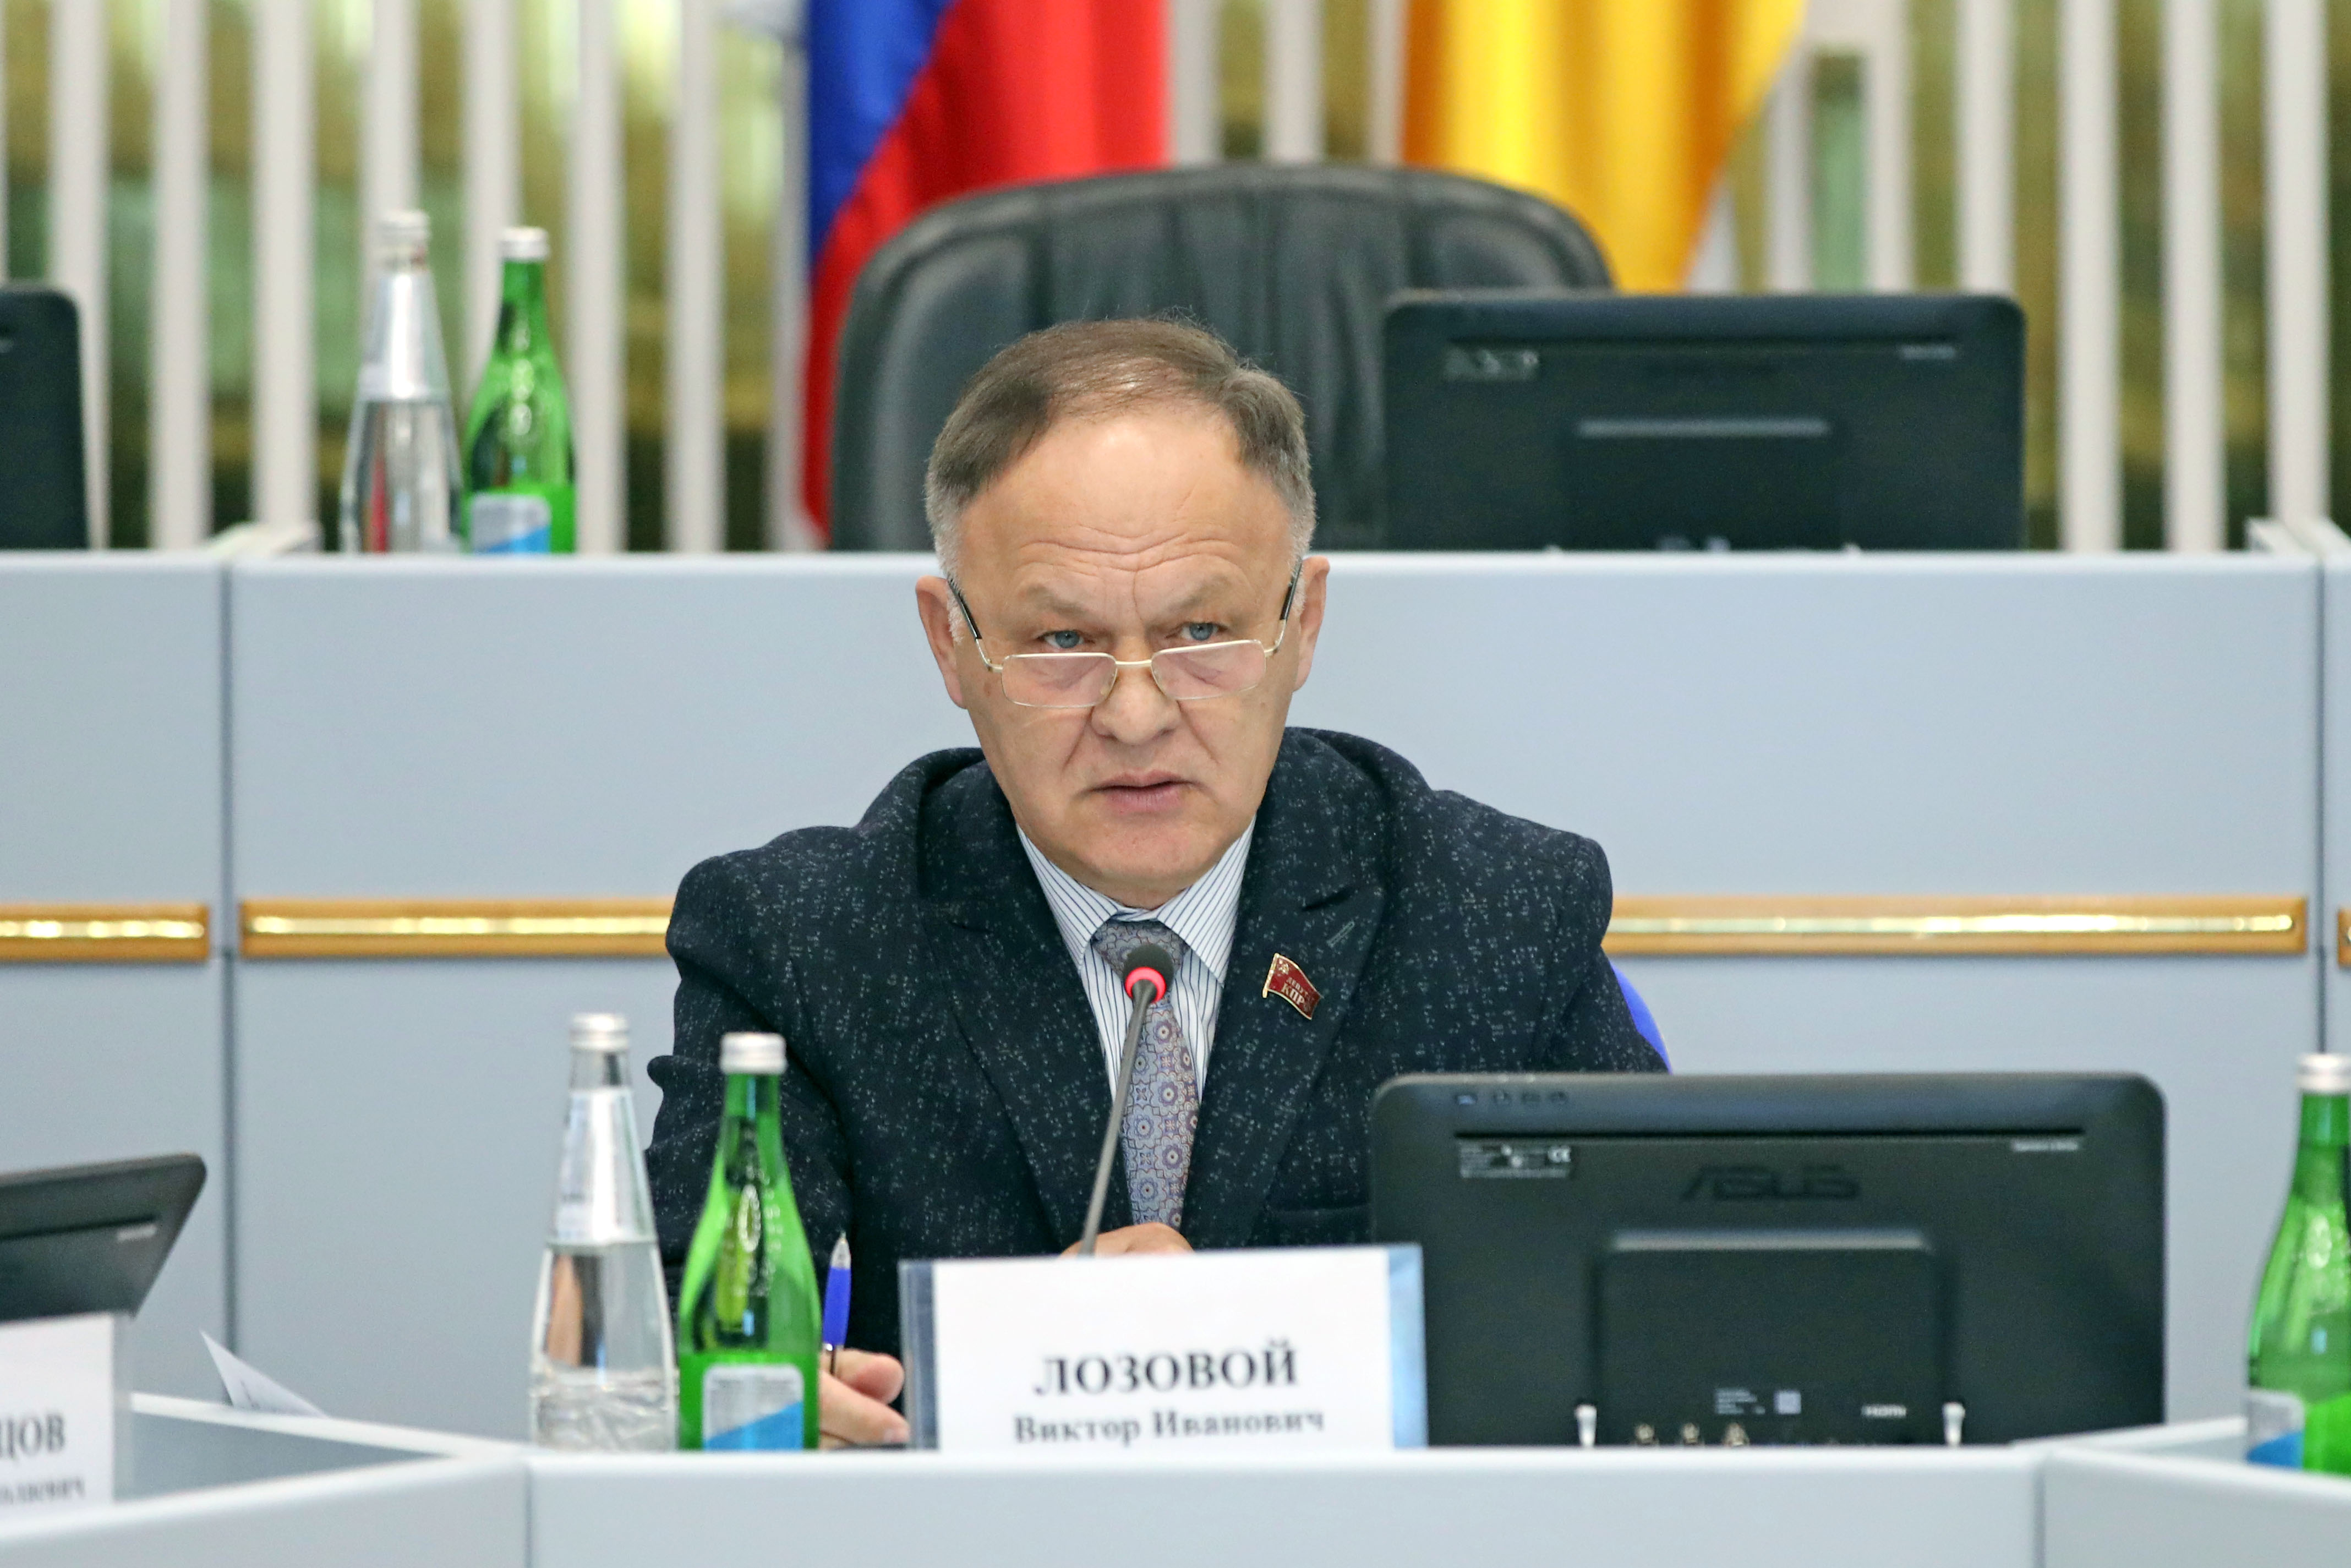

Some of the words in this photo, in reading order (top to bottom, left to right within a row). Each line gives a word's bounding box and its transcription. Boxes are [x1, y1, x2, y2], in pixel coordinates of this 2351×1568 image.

[1033, 1337, 1299, 1396] ЛОЗОВОЙ
[1013, 1413, 1141, 1447] Виктор
[1152, 1409, 1325, 1437] Иванович
